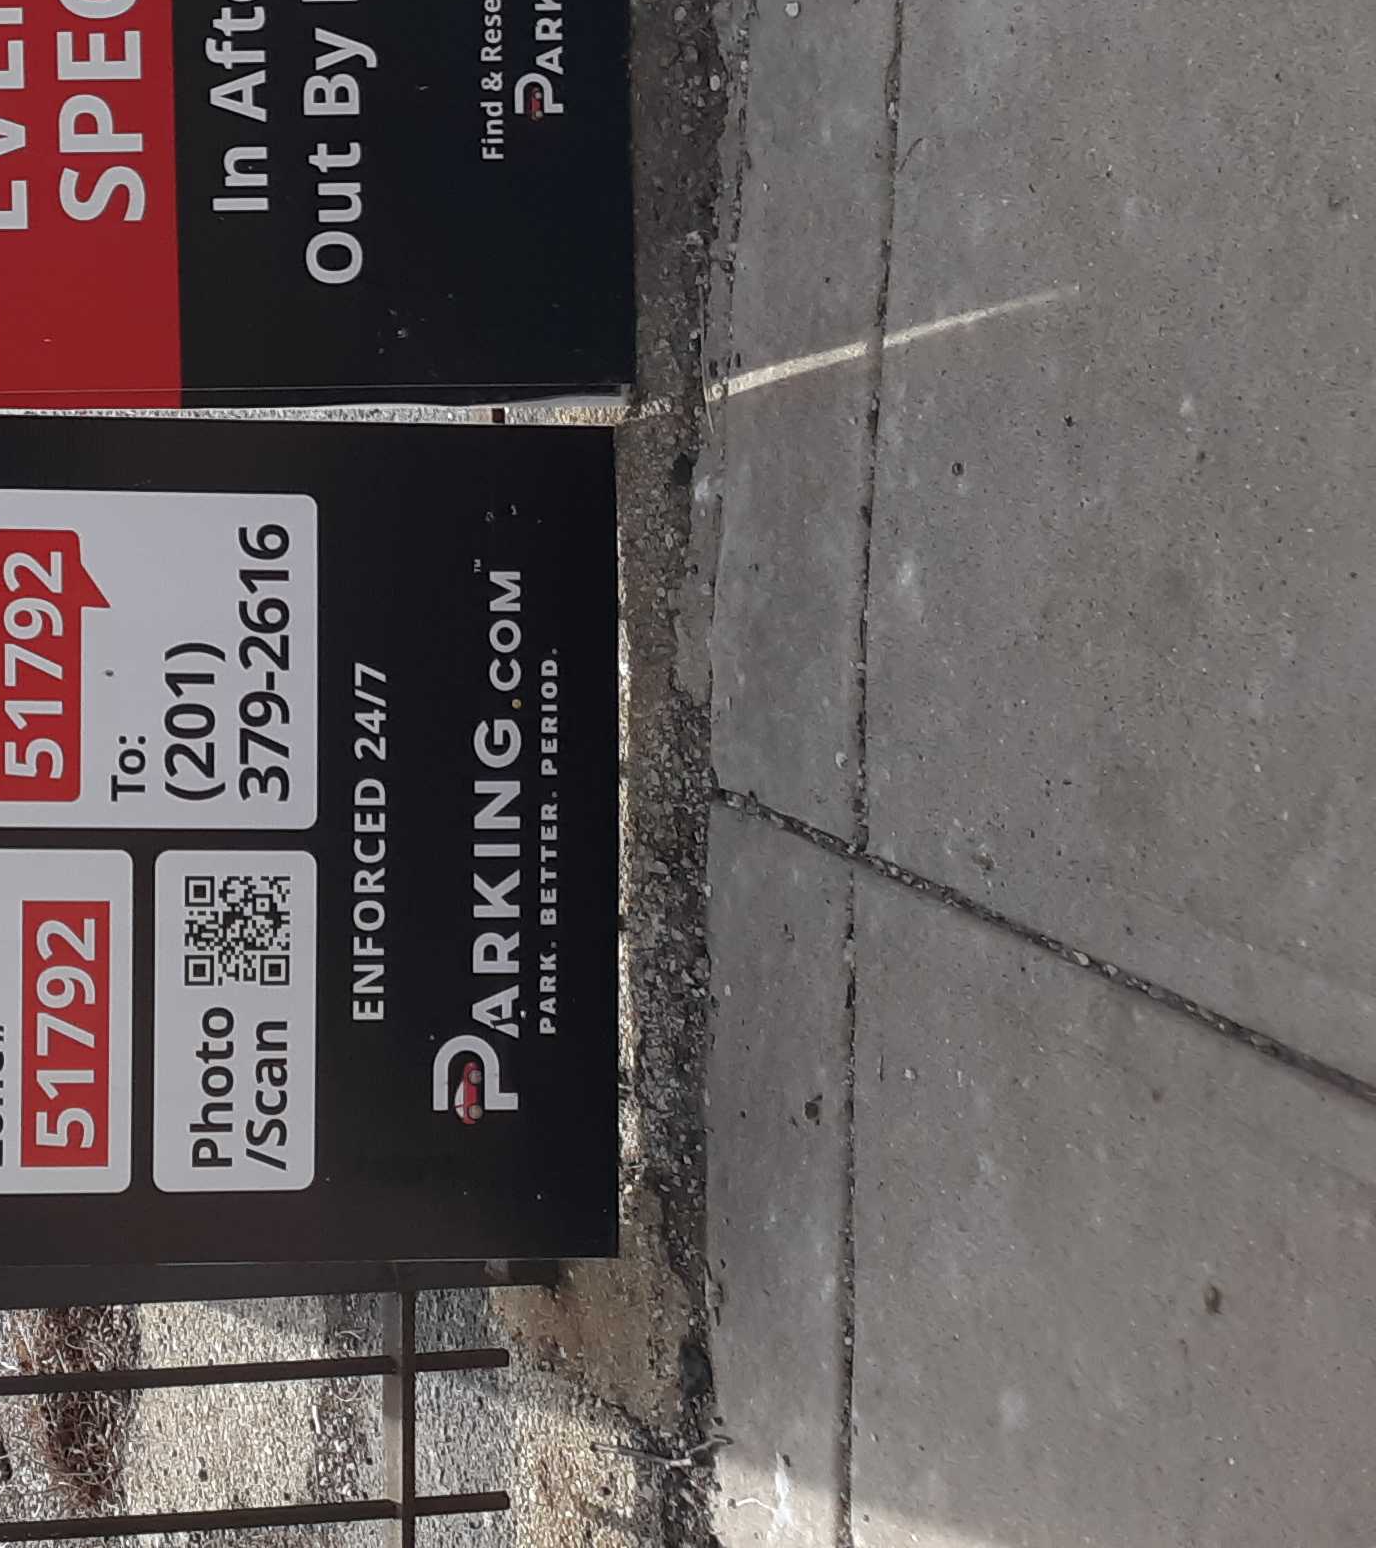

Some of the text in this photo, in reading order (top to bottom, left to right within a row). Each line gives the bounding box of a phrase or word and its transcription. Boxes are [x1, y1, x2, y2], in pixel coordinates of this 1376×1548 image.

[304, 27, 377, 116] By
[480, 102, 504, 160] Find
[481, 71, 504, 92] &
[212, 147, 269, 212] In
[306, 141, 363, 285] Out
[4, 551, 64, 780] 51792
[163, 642, 225, 802] (201)
[238, 523, 291, 803] 379-2616
[111, 735, 146, 802] To:
[352, 662, 388, 1021] ENFORCED 24/7
[539, 649, 558, 1034] PARK. BETTER. PERIOD.
[35, 917, 96, 1149] 51792
[191, 1007, 234, 1169] Photo
[246, 1020, 288, 1171] /Scan
